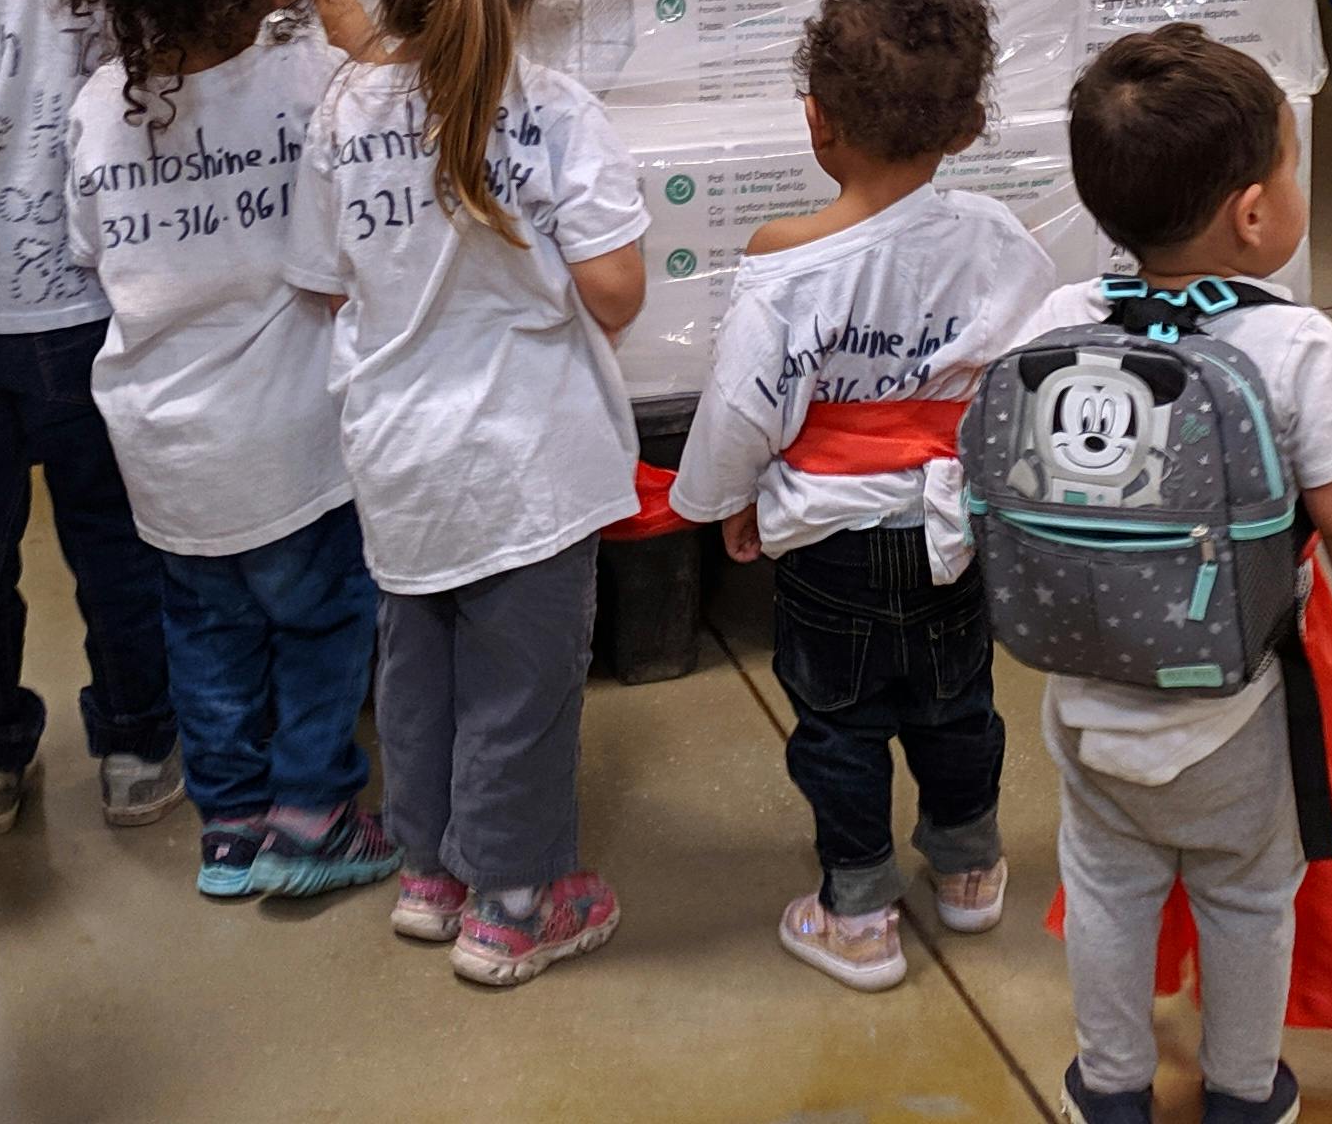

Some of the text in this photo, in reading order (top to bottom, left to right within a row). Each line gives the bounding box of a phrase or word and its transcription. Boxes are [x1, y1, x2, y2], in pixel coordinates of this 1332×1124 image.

[69, 112, 302, 198] learntoshine.in
[753, 169, 789, 181] Design
[789, 167, 804, 176] for
